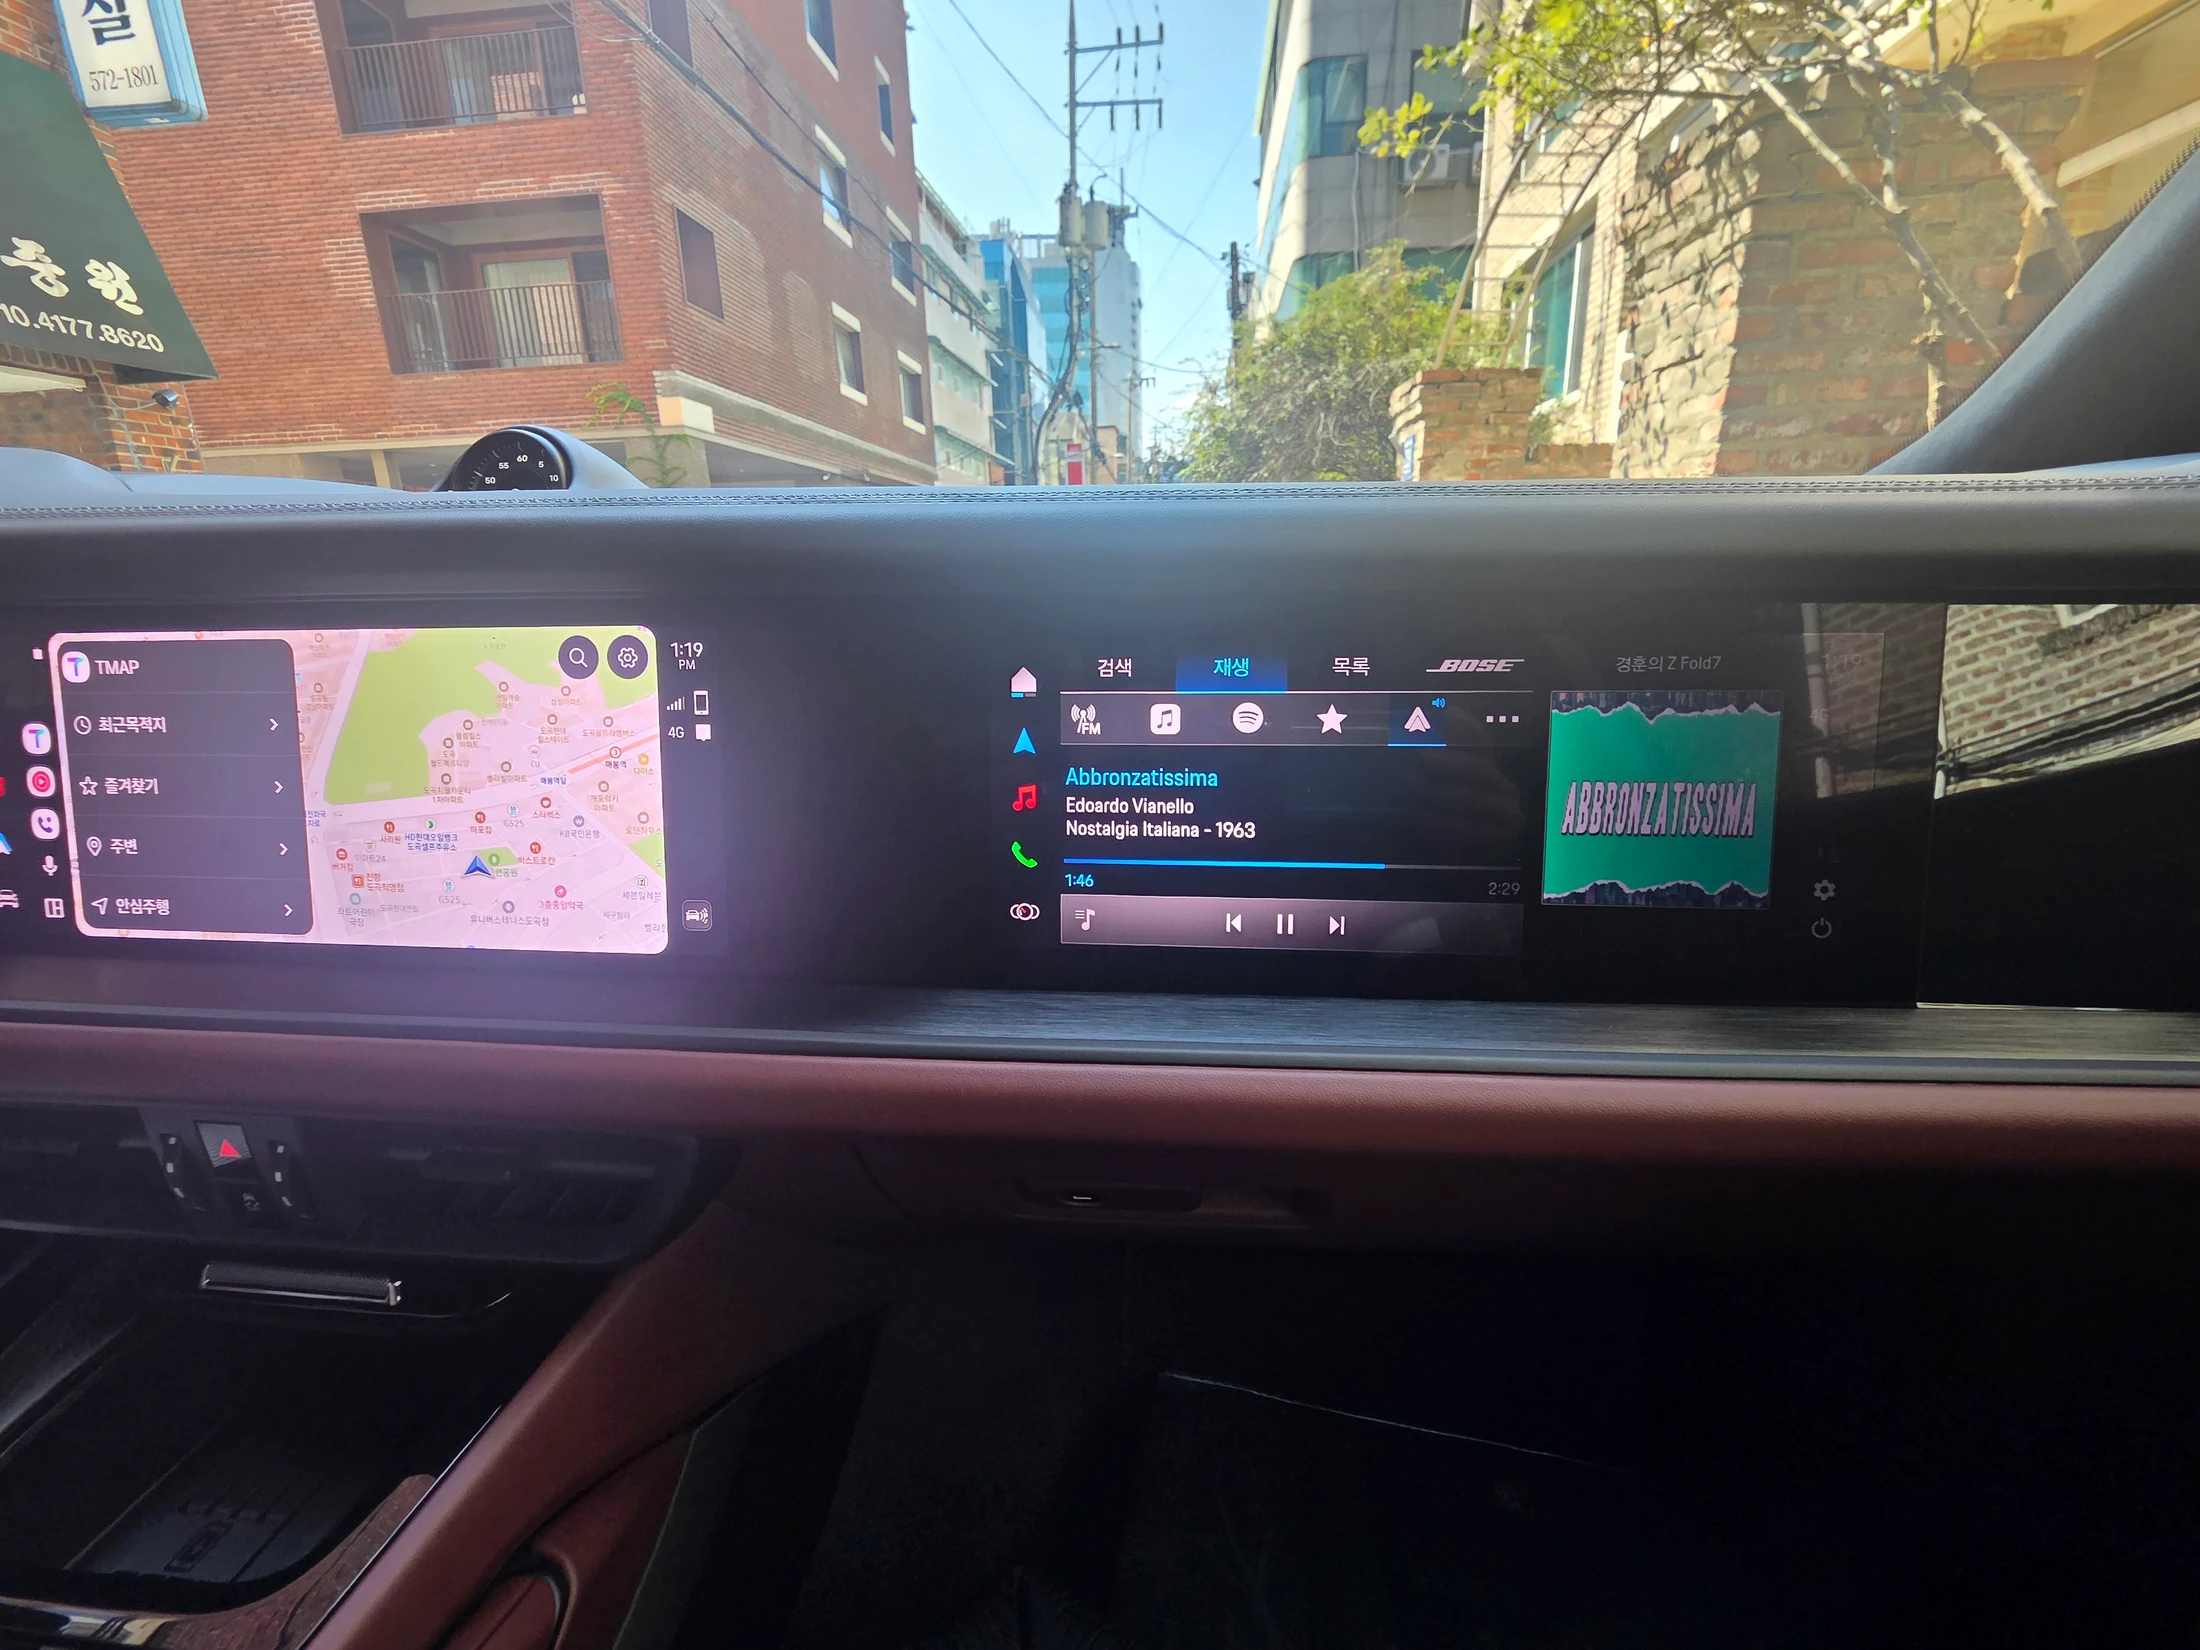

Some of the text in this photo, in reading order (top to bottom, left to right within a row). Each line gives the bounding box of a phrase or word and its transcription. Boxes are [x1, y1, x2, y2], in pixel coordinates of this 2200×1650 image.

[82, 0, 136, 46] 실
[89, 65, 158, 92] 572-1801
[498, 462, 509, 470] 55
[485, 476, 496, 484] 50
[549, 474, 559, 482] 10
[670, 642, 704, 658] 1:19
[95, 660, 140, 675] TMAP
[678, 659, 696, 670] PM
[1097, 658, 1133, 678] 검색
[1213, 657, 1250, 677] 재생
[1332, 657, 1371, 677] 목록
[1426, 658, 1525, 673] BOSE
[1616, 655, 1722, 673] 경훈의 Z Fold7
[98, 716, 167, 733] 최근목적지
[1081, 721, 1101, 735] FM
[668, 726, 685, 739] 4G
[530, 760, 541, 768] CU
[605, 760, 627, 769] 매봉역
[634, 767, 654, 775] 다이소
[1065, 767, 1219, 787] Abbronzatissima
[104, 777, 160, 796] 즐겨찾기
[1066, 796, 1195, 815] Edoardo Vianello
[1560, 781, 1757, 837] ABBRONZATISSIMA
[532, 811, 561, 819] 스타벅스
[503, 819, 525, 828] GS25
[1066, 819, 1139, 840] Nostalgia
[1142, 820, 1200, 838] Italiana
[1215, 821, 1256, 839] 1963
[380, 835, 401, 845] 사리원
[404, 833, 458, 843] HD현대오일뱅크
[560, 829, 600, 839] KB국민은행
[110, 838, 138, 855] 주변
[407, 842, 457, 852] 도곡셀프주유소
[354, 854, 386, 863] 이마트24
[517, 856, 555, 866] 비스트로칸
[332, 863, 354, 872] 버거킹
[1064, 873, 1094, 888] 1:46
[1488, 881, 1521, 896] 2:29
[438, 895, 461, 904] GS25
[622, 891, 662, 901] 세븐일레븐
[115, 898, 171, 916] 안심주행
